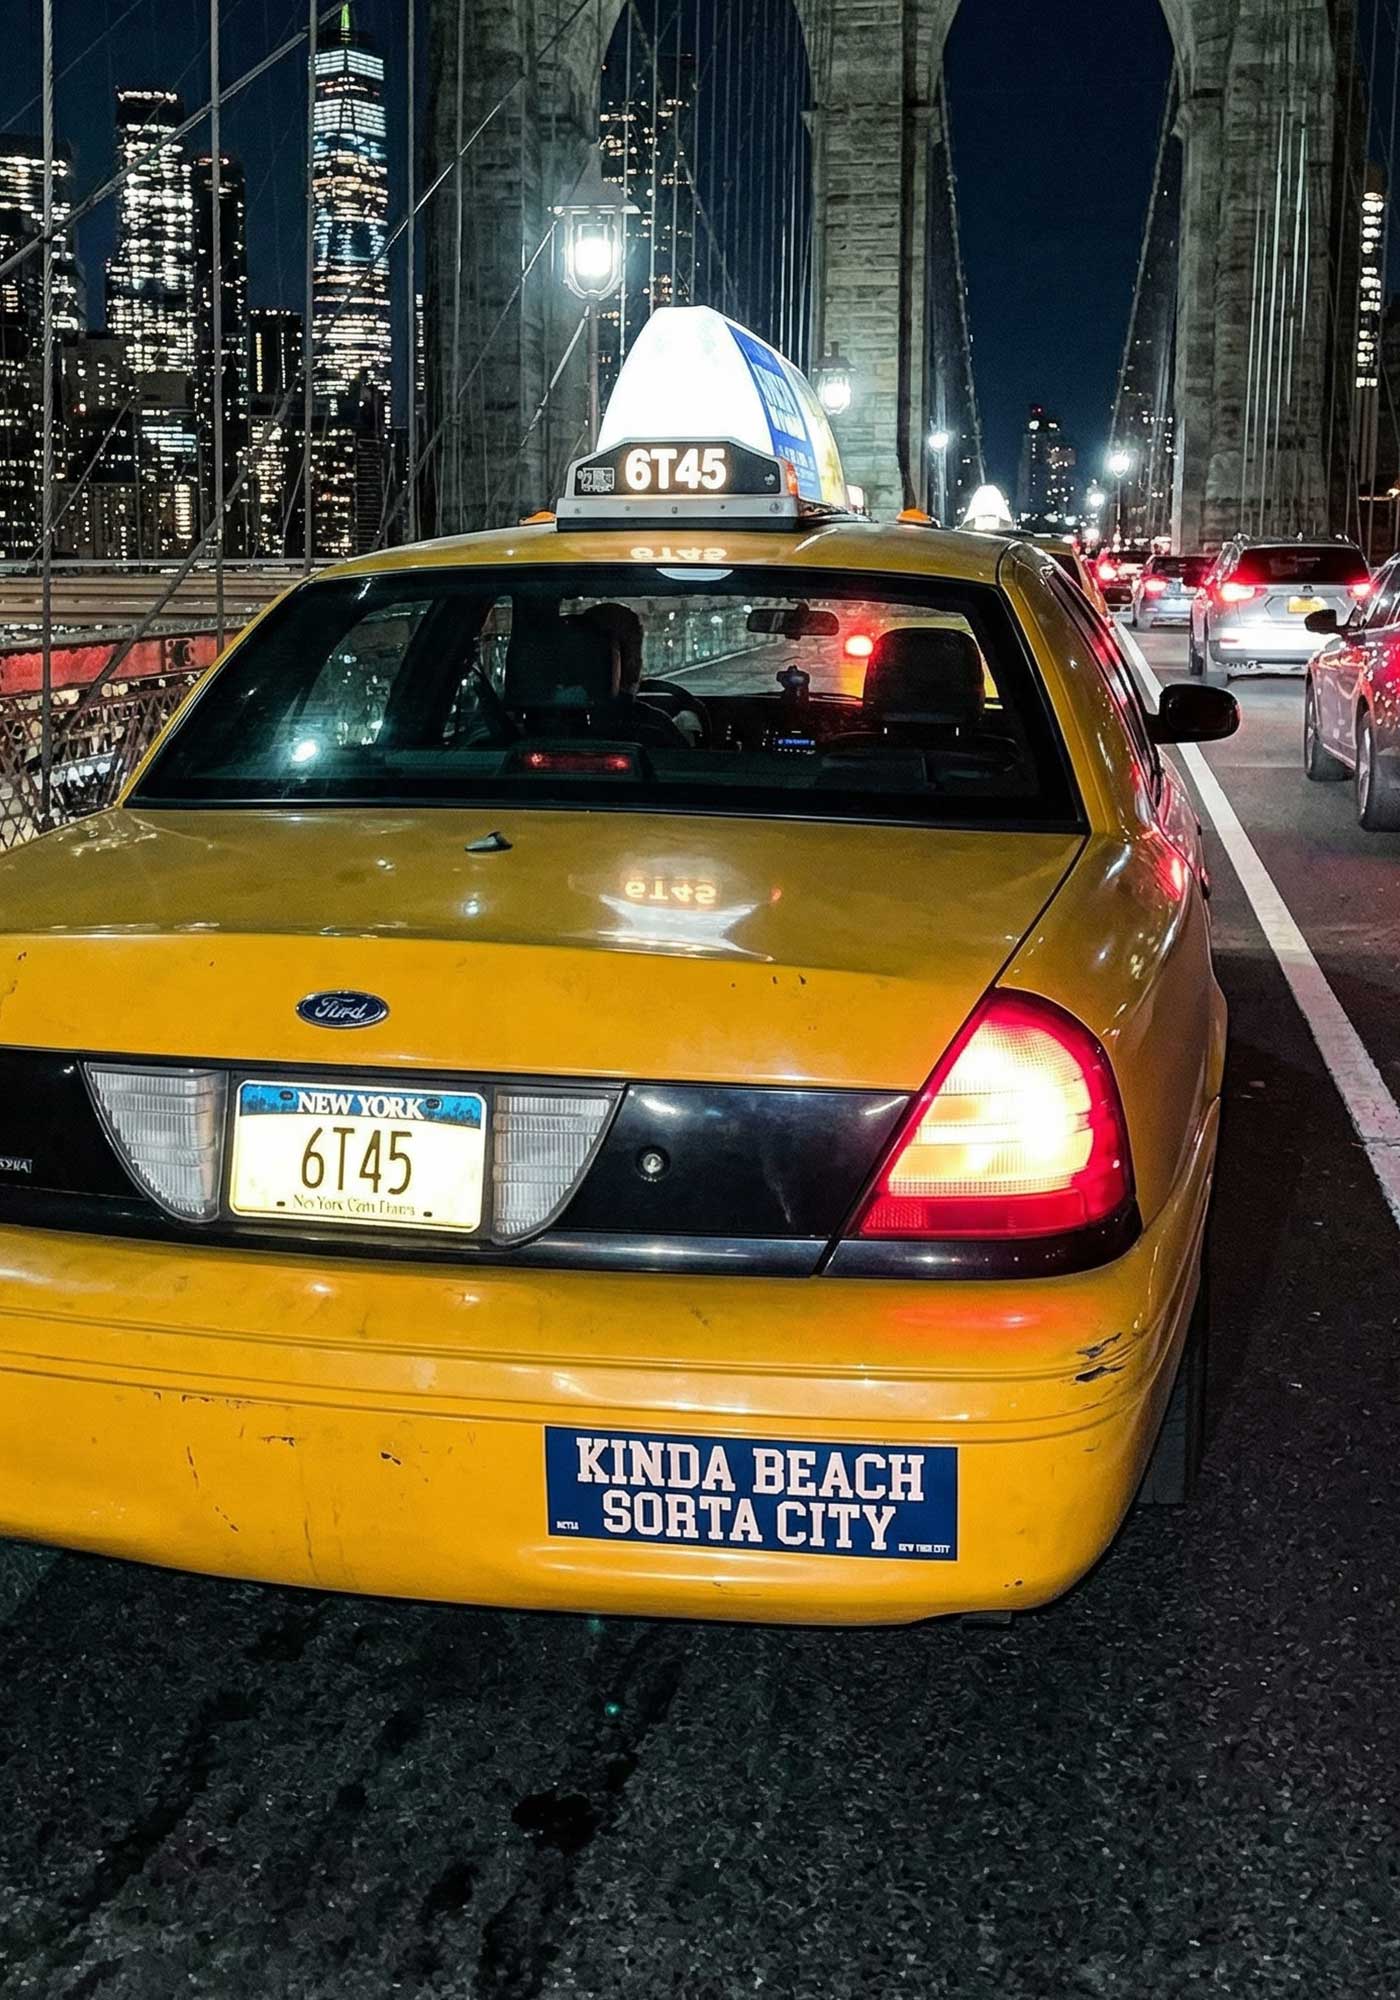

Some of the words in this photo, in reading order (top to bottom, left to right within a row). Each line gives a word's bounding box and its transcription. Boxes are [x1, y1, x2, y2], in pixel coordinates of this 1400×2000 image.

[625, 448, 727, 490] 6T45
[314, 996, 369, 1020] Ford
[297, 1091, 353, 1116] NEW
[359, 1095, 425, 1119] YORK
[301, 1126, 413, 1195] 6T45
[576, 1437, 736, 1492] KINDA
[753, 1447, 925, 1501] BEACH
[603, 1489, 763, 1543] SORTA
[776, 1500, 897, 1551] CITY
